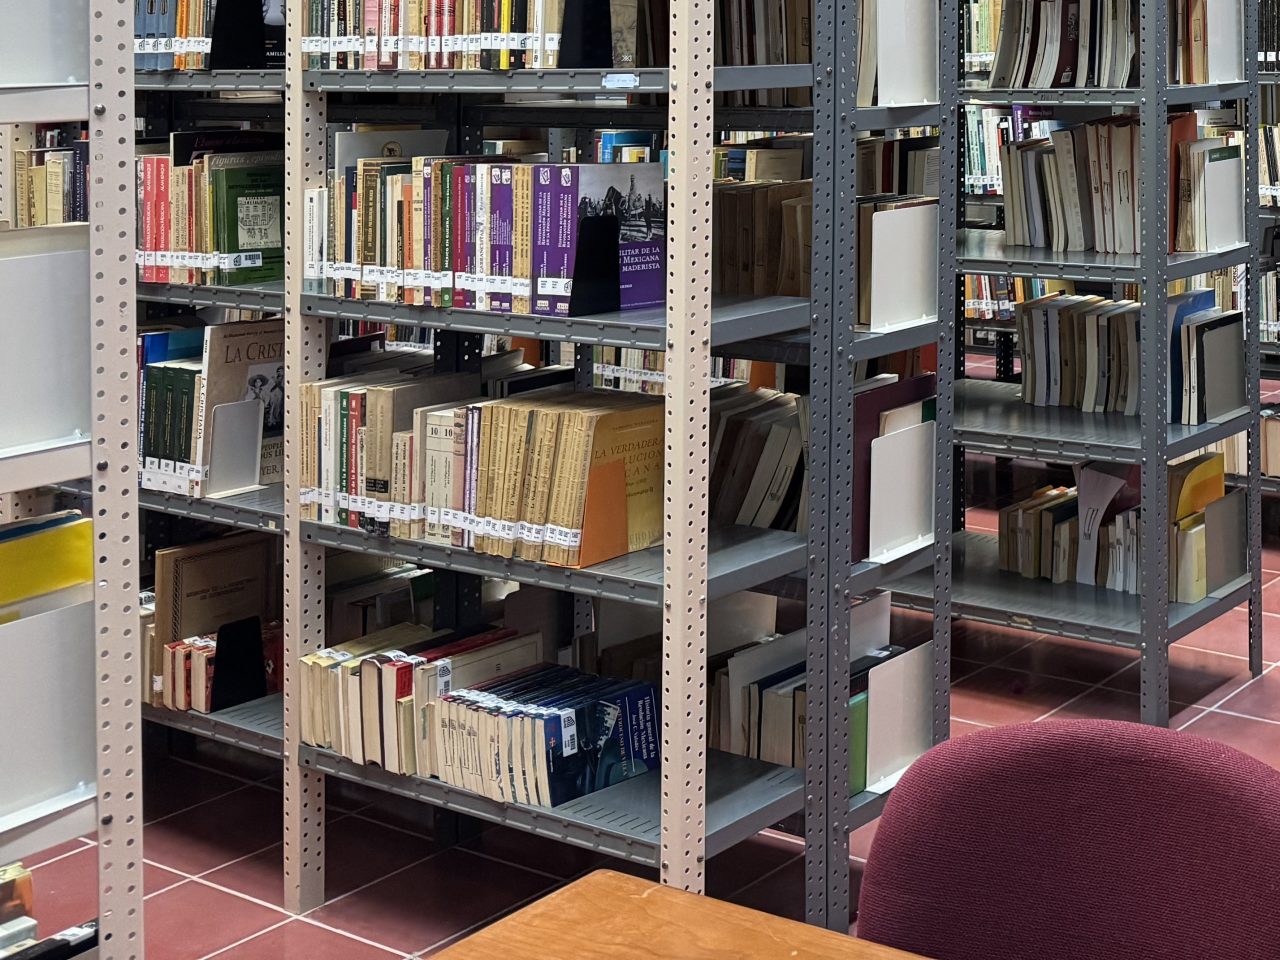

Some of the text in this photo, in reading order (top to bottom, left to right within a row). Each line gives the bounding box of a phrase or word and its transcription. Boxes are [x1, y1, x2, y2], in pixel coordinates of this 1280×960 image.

[623, 254, 660, 264] MEXICANA
[622, 262, 661, 272] MADERISTA
[224, 342, 284, 364] LA CRIST
[594, 448, 606, 459] LA
[623, 450, 662, 465] LUCION
[261, 465, 279, 477] YER,
[644, 696, 652, 721] Historia
[646, 721, 654, 742] general
[640, 730, 648, 759] Mexicana
